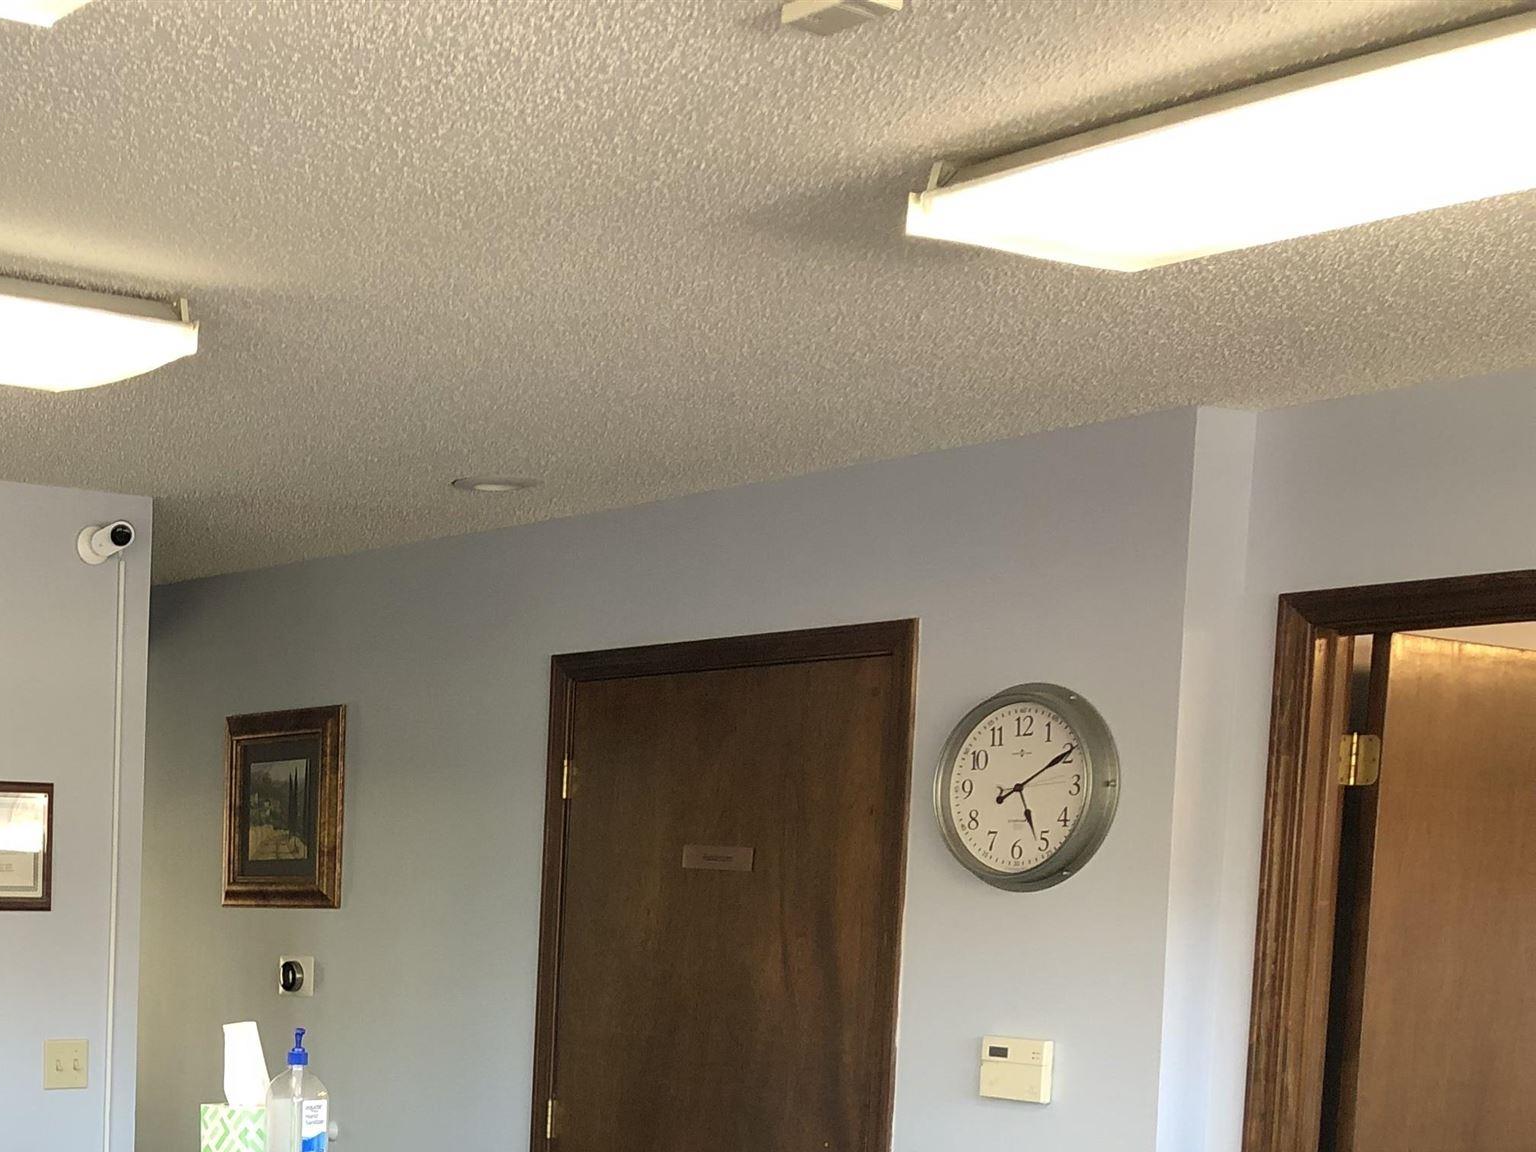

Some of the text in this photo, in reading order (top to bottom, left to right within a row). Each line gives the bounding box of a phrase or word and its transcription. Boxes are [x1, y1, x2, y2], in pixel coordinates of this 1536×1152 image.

[990, 725, 1004, 747] 11
[1014, 714, 1034, 738] 12
[1045, 721, 1053, 743] 1
[970, 749, 989, 771] 10
[1062, 742, 1074, 764] 2
[961, 778, 974, 800] 9
[1068, 774, 1081, 796] 3
[967, 809, 979, 831] 8
[1057, 806, 1070, 827] 4
[987, 830, 999, 852] 7
[1010, 838, 1023, 860] 6
[1037, 830, 1050, 852] 5
